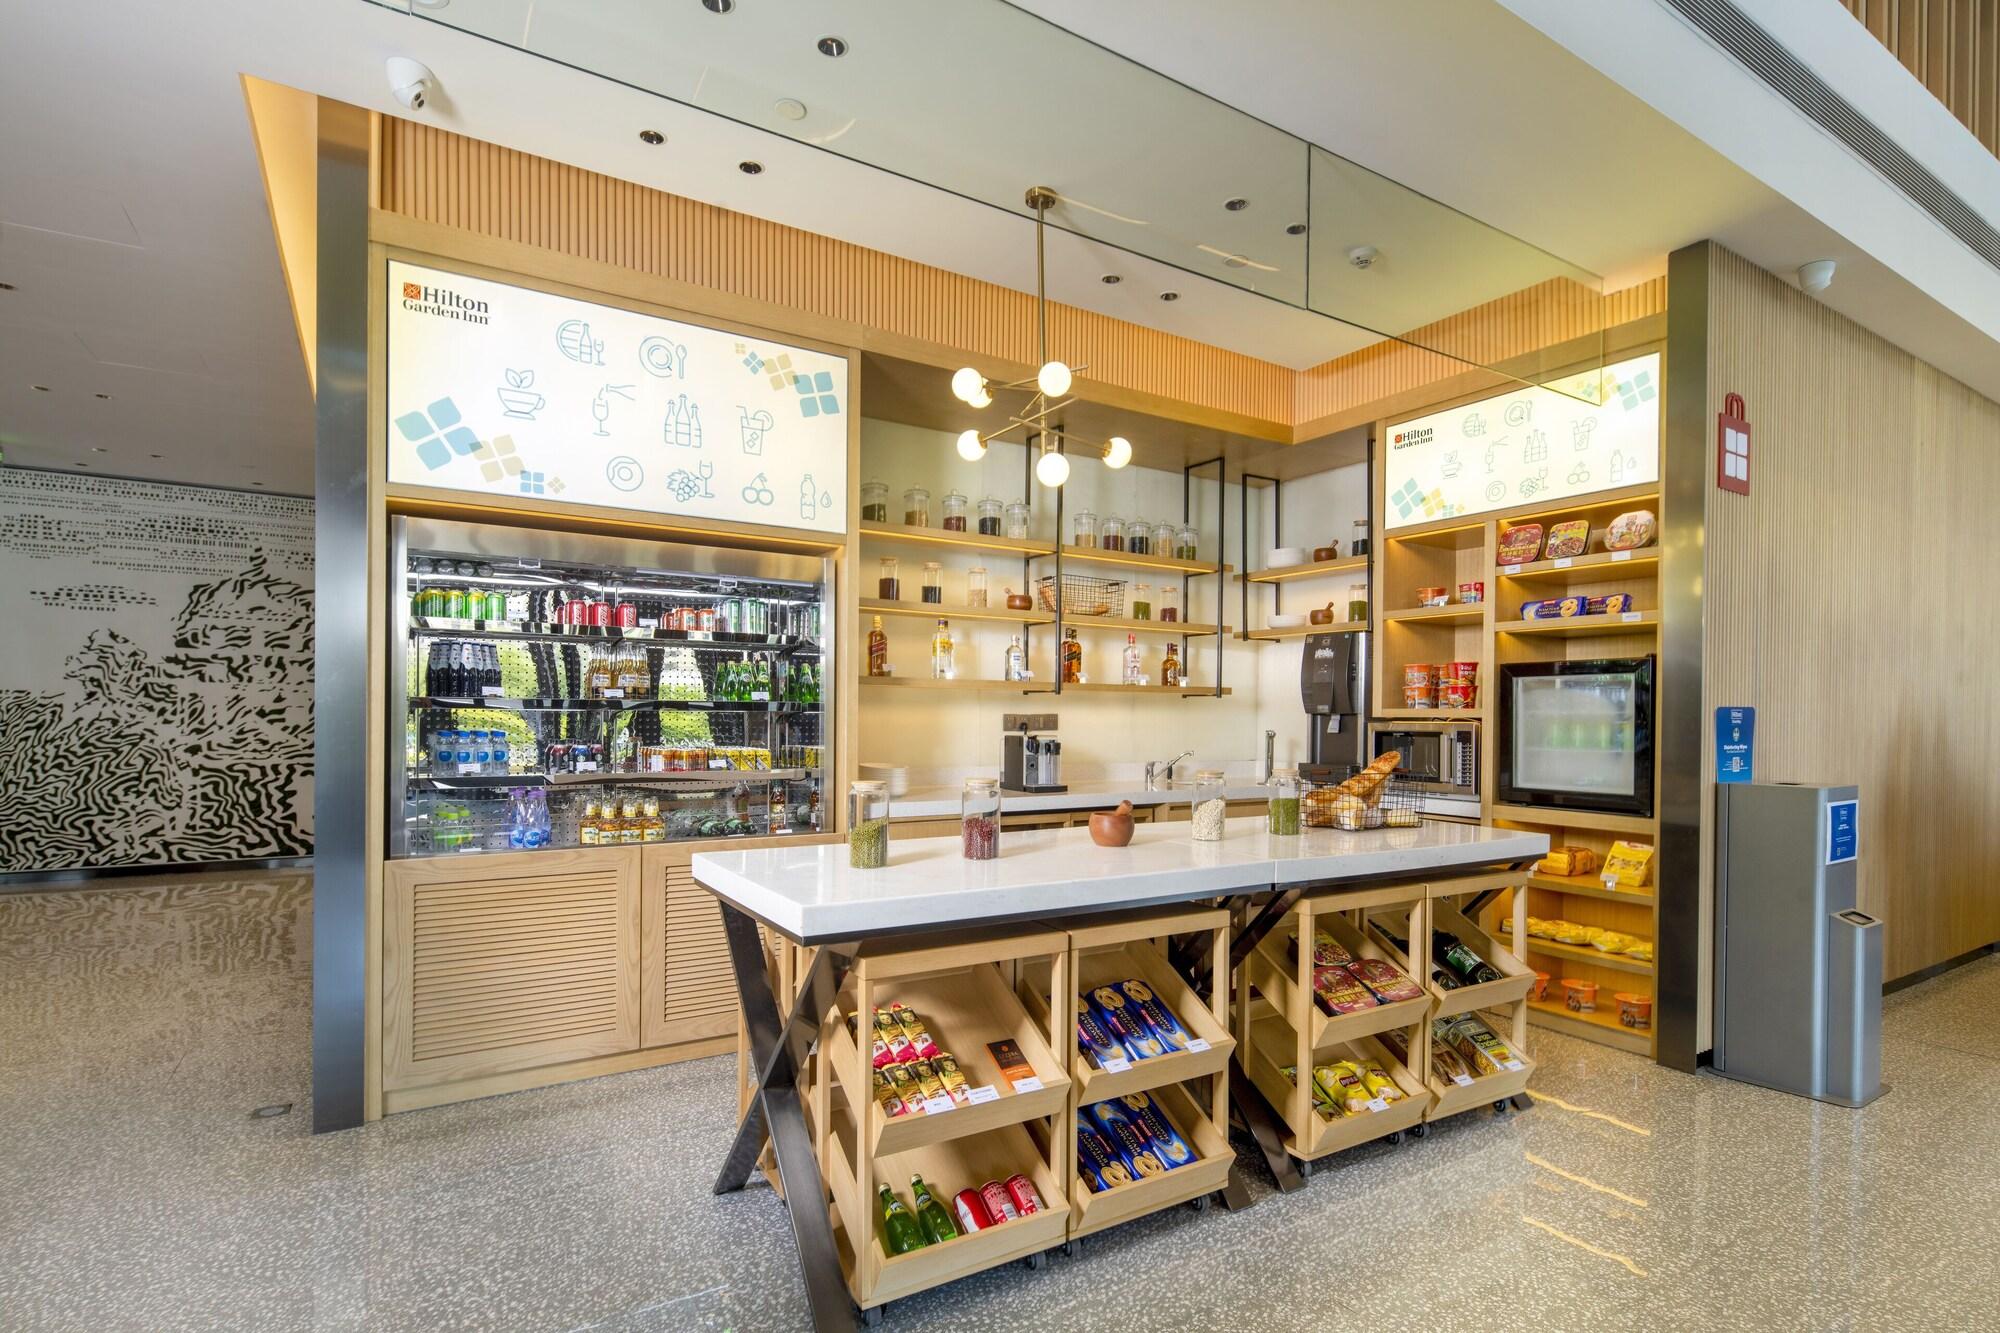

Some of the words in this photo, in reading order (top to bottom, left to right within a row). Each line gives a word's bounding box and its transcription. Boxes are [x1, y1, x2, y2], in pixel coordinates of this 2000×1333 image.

[423, 286, 489, 313] Hilton
[402, 299, 460, 320] Garden
[463, 310, 489, 325] Inn
[1403, 427, 1433, 441] Hilton
[1420, 436, 1433, 444] Inn
